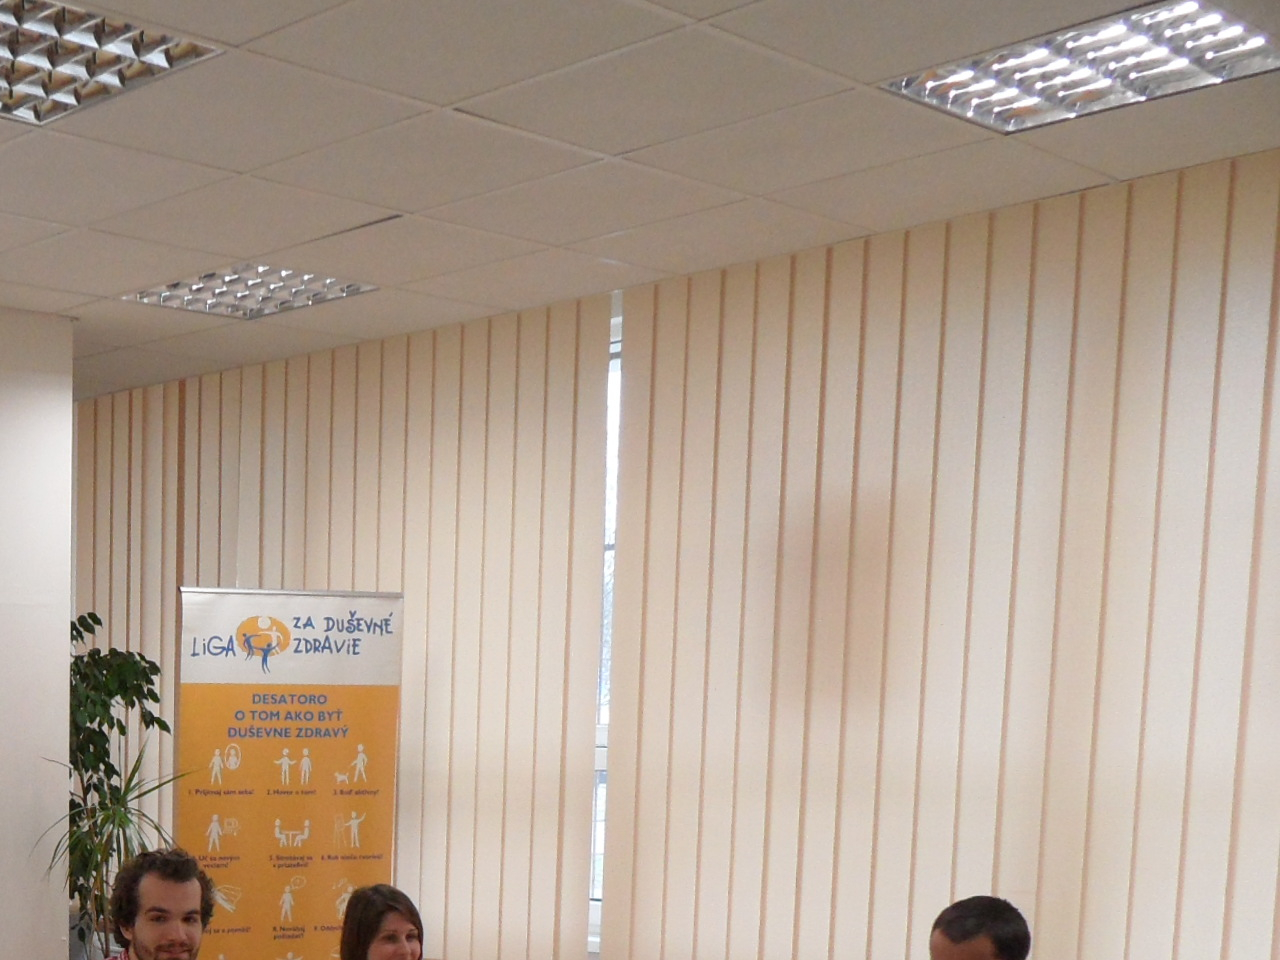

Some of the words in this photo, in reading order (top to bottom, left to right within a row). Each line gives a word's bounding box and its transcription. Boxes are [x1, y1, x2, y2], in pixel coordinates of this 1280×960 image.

[293, 616, 315, 630] ZA
[323, 610, 393, 637] DUŠEVNÉ
[252, 693, 328, 705] DESATORO
[234, 710, 245, 721] O
[250, 710, 280, 721] TOM
[284, 710, 314, 721] AKO
[227, 725, 291, 738] DUŠEVNE
[295, 725, 349, 738] ZDRAVÝ
